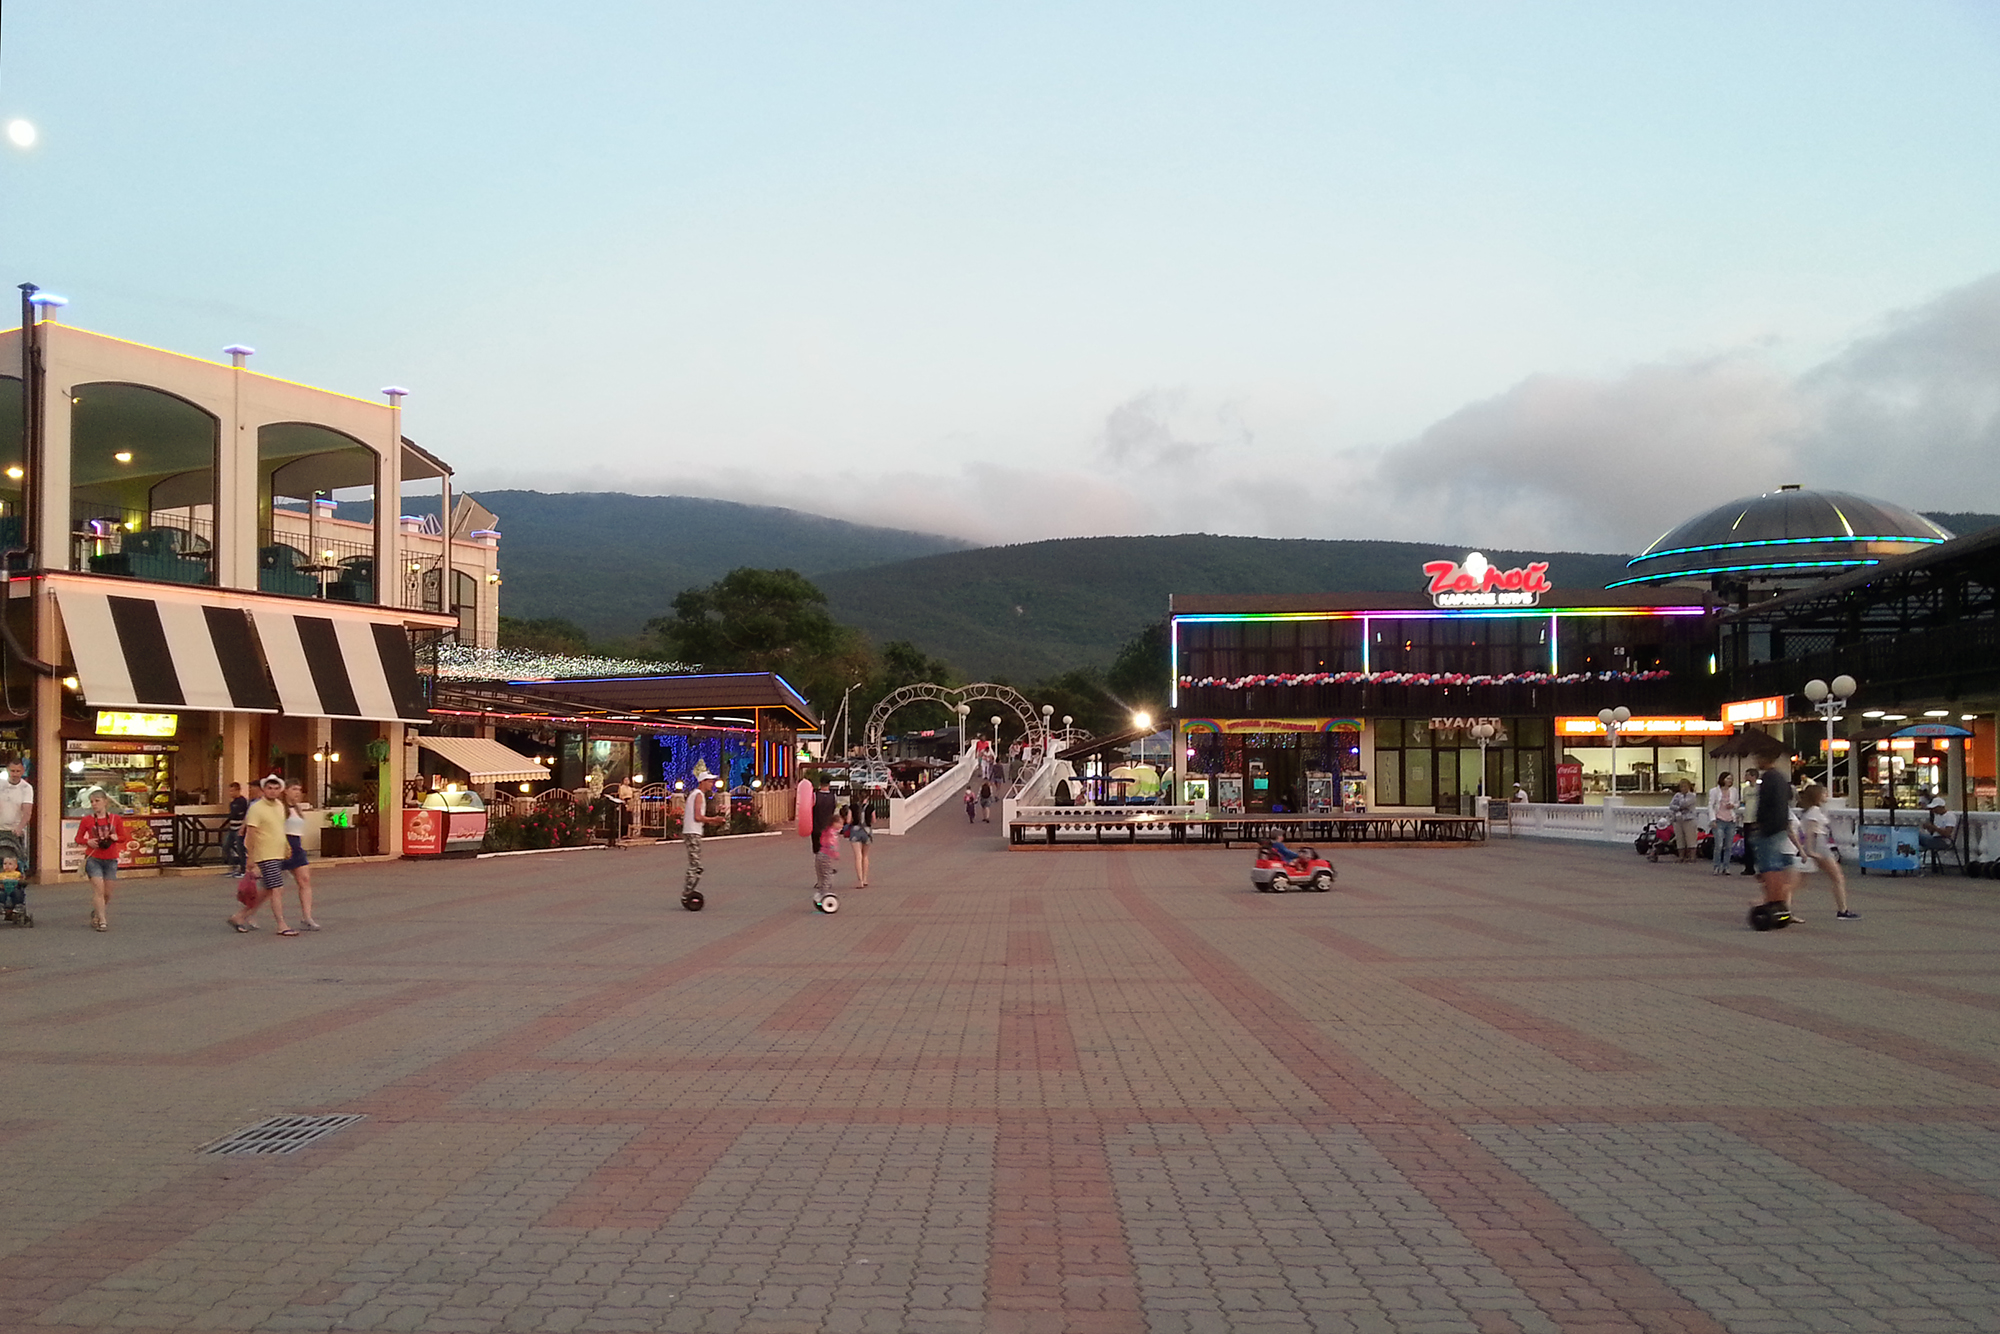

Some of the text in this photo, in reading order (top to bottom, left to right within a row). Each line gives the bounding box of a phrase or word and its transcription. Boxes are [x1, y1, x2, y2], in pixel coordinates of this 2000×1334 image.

[1439, 592, 1532, 605] КАРАОКЕ КЛУБ
[1431, 717, 1500, 728] ТУАЛЕТ
[1914, 727, 1946, 735] ПРОКАТ
[1863, 834, 1886, 842] ПРОКАТ
